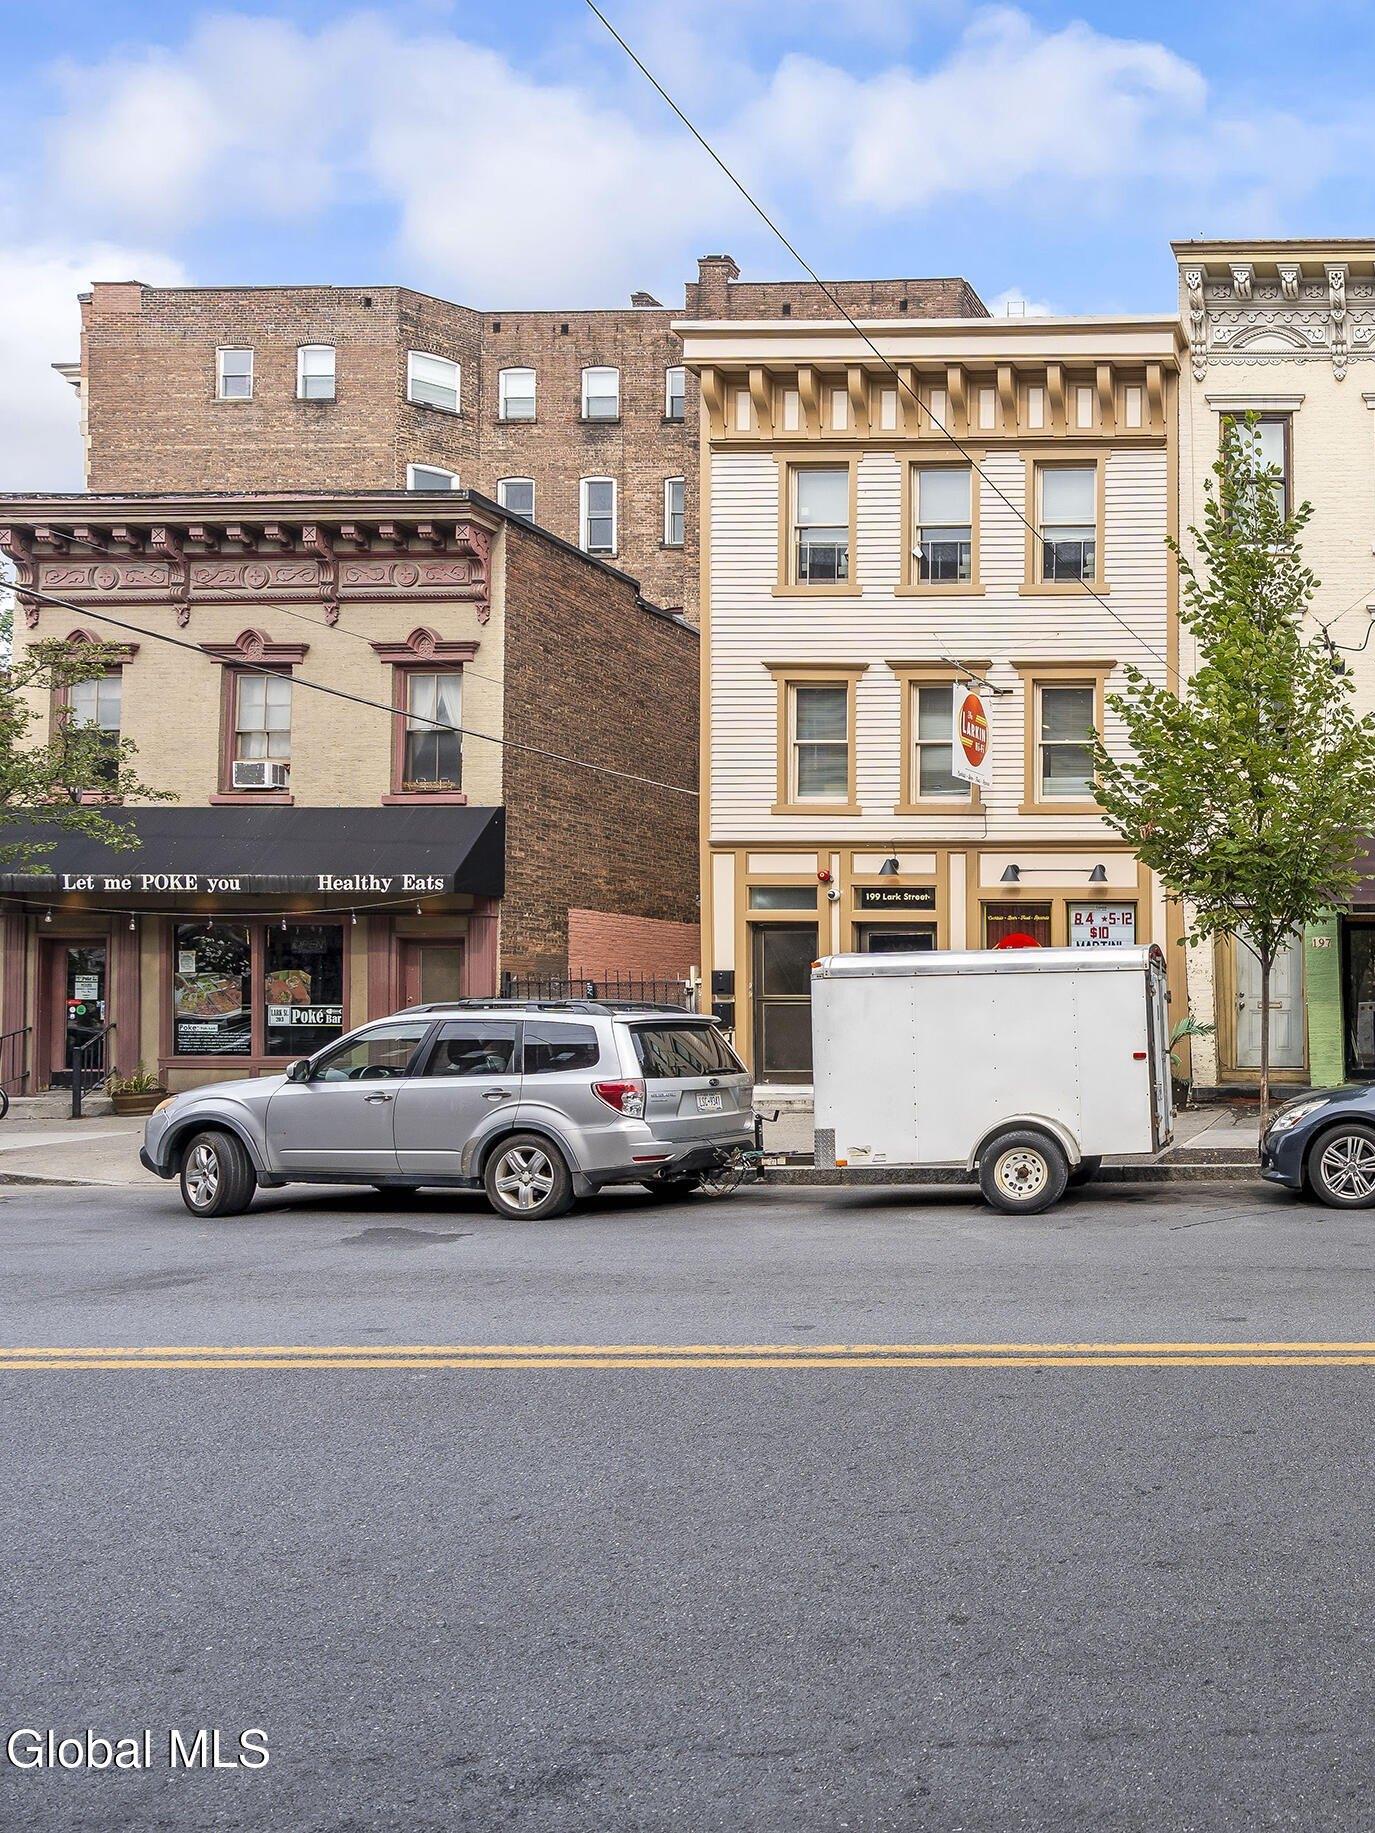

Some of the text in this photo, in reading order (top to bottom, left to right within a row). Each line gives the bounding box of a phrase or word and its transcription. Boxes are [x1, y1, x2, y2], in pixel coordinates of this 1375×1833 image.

[962, 711, 986, 743] LARKIN
[62, 873, 242, 893] Let me POKE you
[317, 873, 445, 893] Healthy Eats
[865, 892, 881, 901] 199
[882, 892, 902, 901] Lark
[1090, 926, 1109, 939] $10
[1313, 938, 1332, 948] 197
[292, 1008, 324, 1024] Poké
[325, 1014, 342, 1024] Bar
